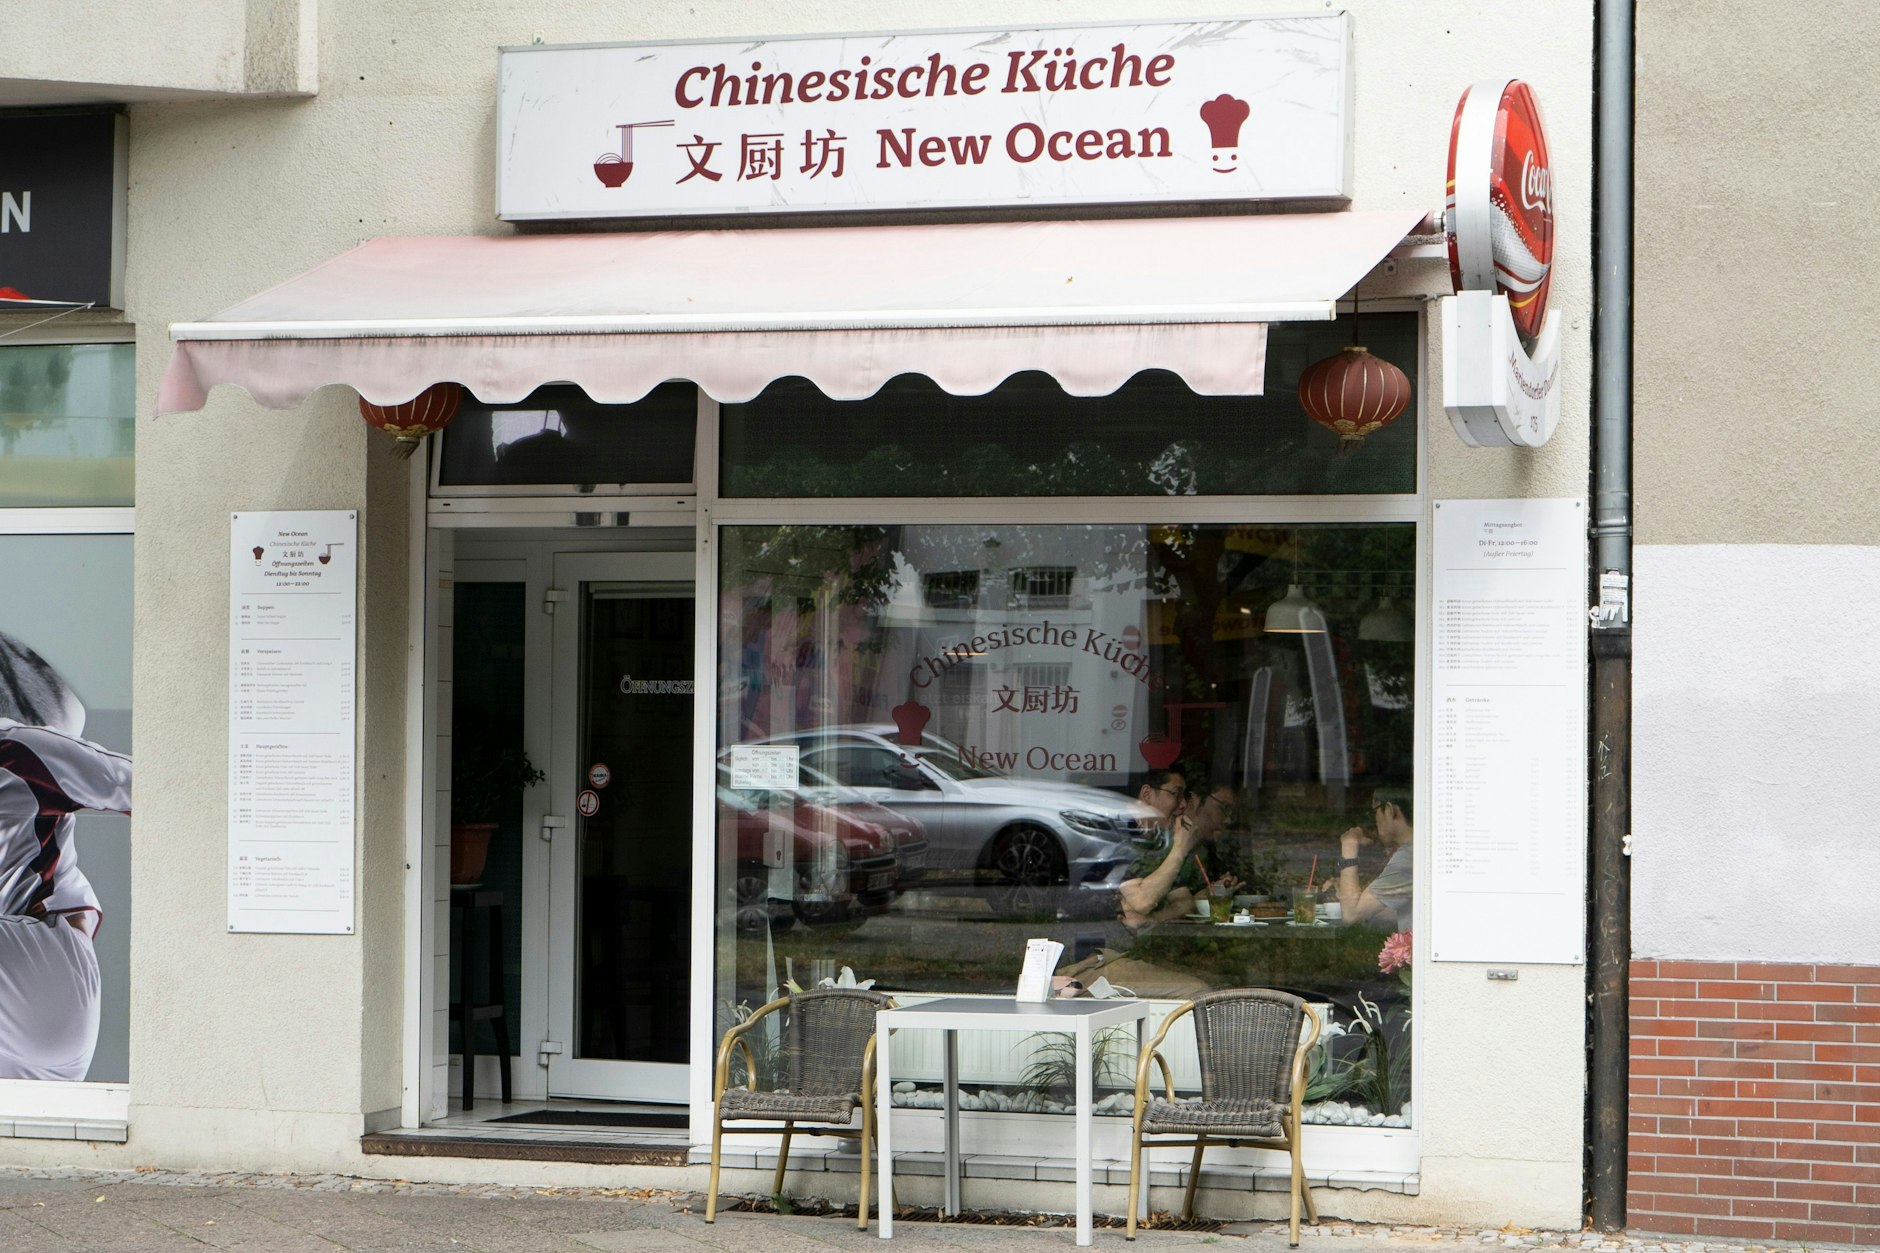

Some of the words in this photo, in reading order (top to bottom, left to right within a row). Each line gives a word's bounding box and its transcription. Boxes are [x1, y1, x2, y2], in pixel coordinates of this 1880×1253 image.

[675, 53, 989, 109] Chinesische
[1001, 43, 1175, 94] Küche
[676, 129, 848, 185] 文厨坊
[877, 128, 991, 169] New
[1006, 122, 1173, 164] Ocean
[271, 560, 314, 568] Öffnungszeiten
[298, 570, 321, 578] Sonntag
[909, 620, 1077, 689] Chinesische
[1082, 628, 1165, 690] Küche
[620, 674, 694, 694] ÖFFNUNGSZ
[992, 685, 1080, 714] 文厨坊
[957, 745, 1019, 769] New
[1026, 746, 1118, 772] Ocean
